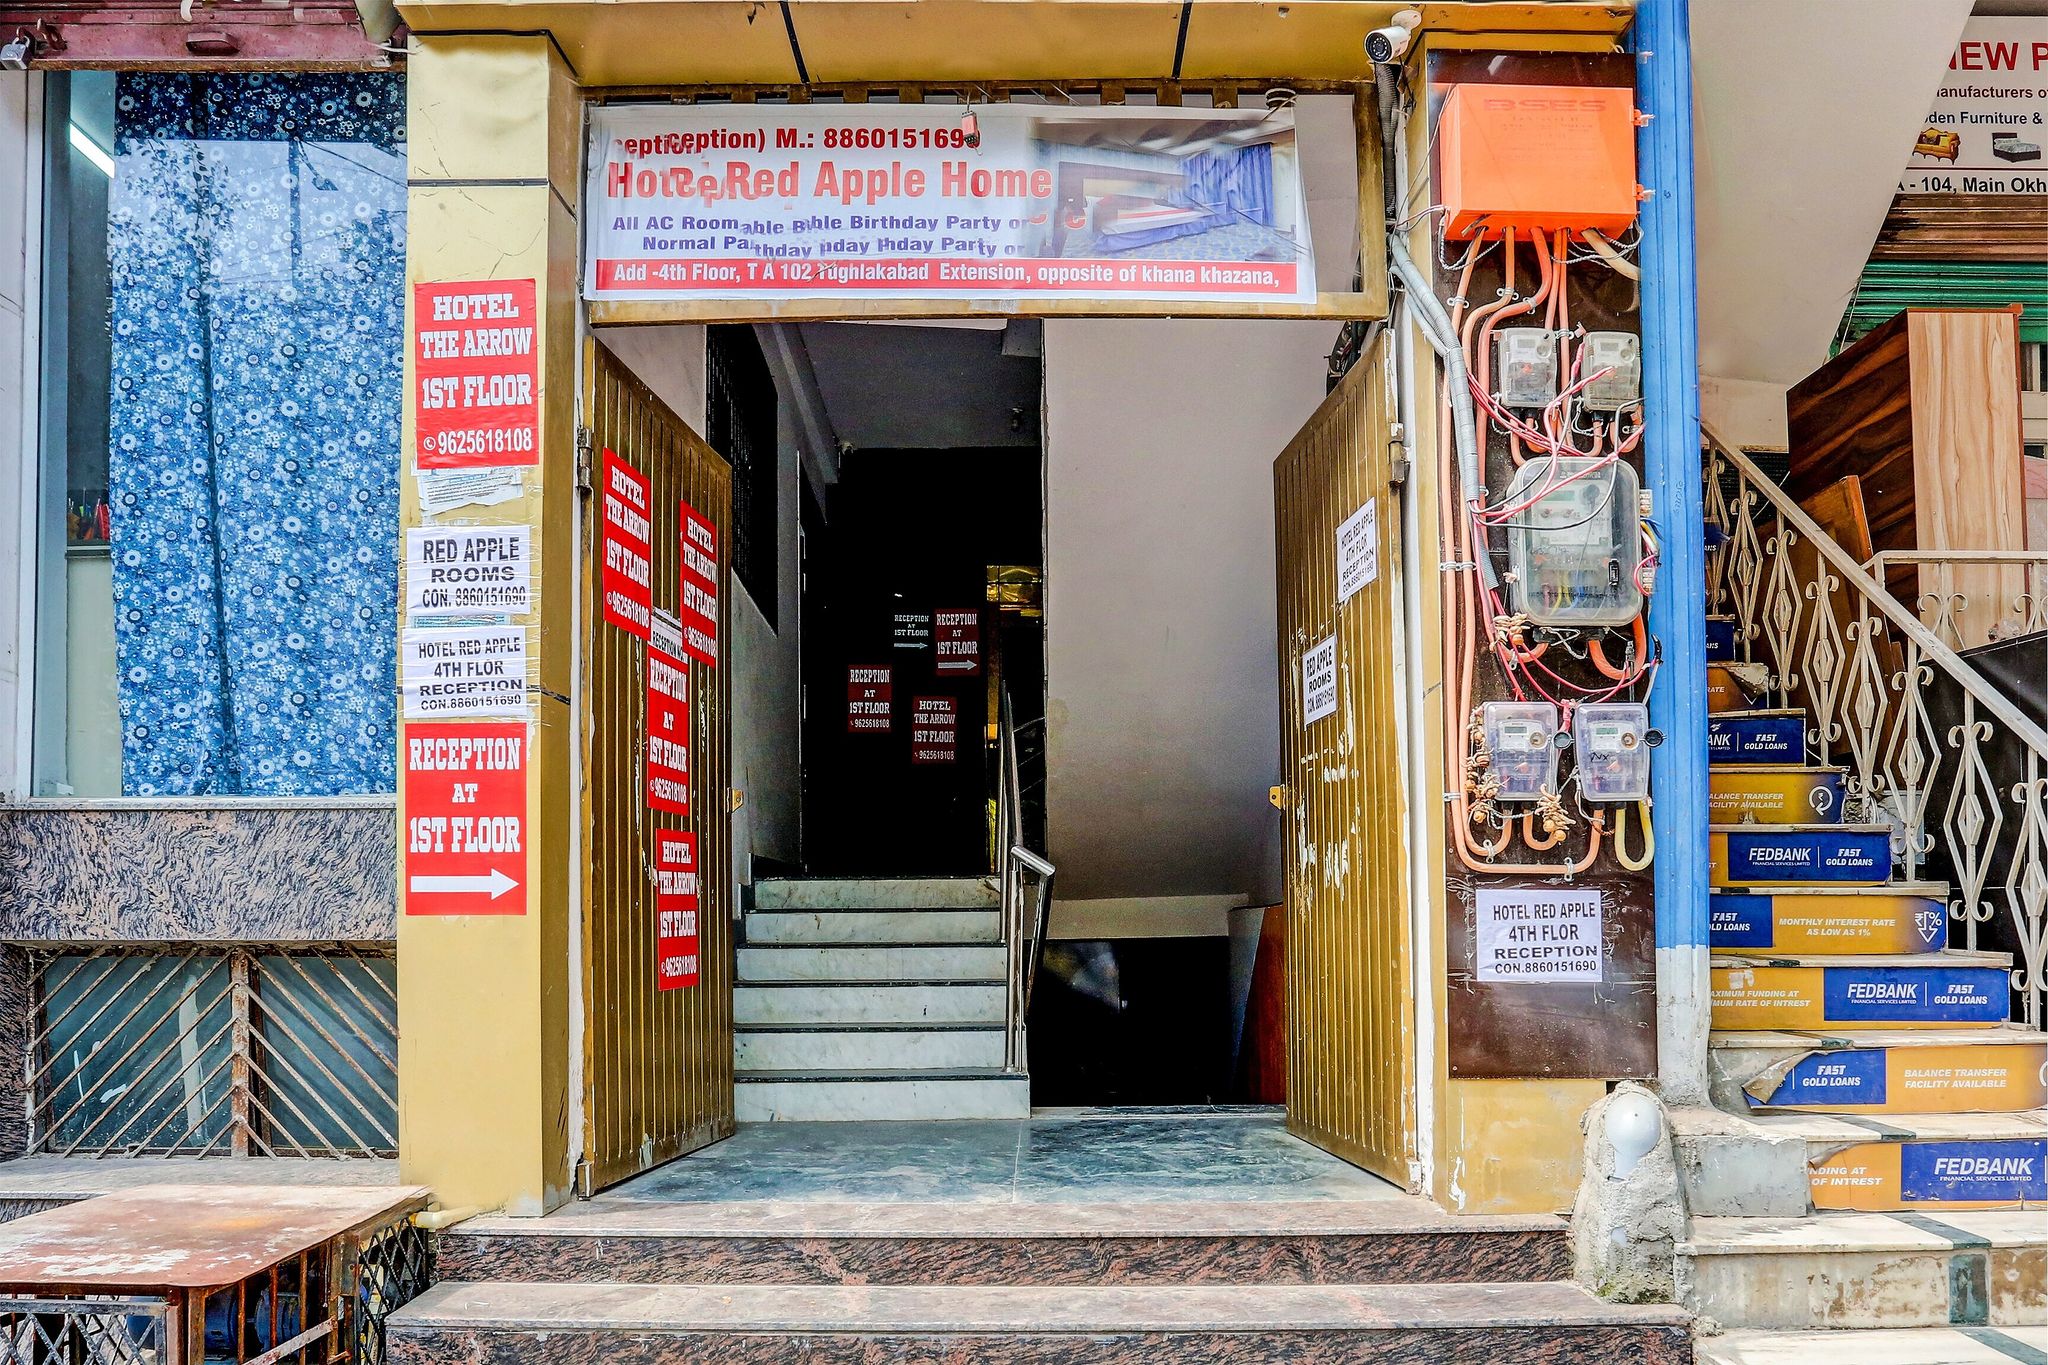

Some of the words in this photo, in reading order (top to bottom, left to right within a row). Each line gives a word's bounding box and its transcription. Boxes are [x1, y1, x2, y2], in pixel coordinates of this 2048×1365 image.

[1925, 112, 1955, 124] den
[1960, 112, 2027, 124] Furniture
[2032, 112, 2043, 124] &
[776, 128, 814, 149] M.:
[813, 161, 926, 206] Apple
[942, 161, 1052, 198] Home
[1921, 177, 1957, 194] 104,
[1963, 178, 2005, 193] Main
[612, 216, 639, 231] All
[646, 216, 674, 231] AC
[850, 215, 938, 232] Birthday
[946, 215, 1002, 232] Party
[643, 237, 716, 251] Normal
[614, 264, 647, 281] Add
[652, 264, 687, 281] -4th
[692, 264, 741, 283] Floor,
[747, 264, 757, 281] T
[763, 264, 775, 281] A
[781, 264, 811, 281] 102
[817, 263, 929, 284] Tughlakabad
[940, 264, 1032, 283] Extension,
[1037, 265, 1114, 284] opposite
[1119, 265, 1137, 282] of
[1142, 266, 1195, 283] khana
[1200, 266, 1280, 287] khazana,
[432, 293, 519, 321] HOTEL
[420, 330, 459, 359] THE
[463, 327, 532, 357] ARROW
[422, 377, 458, 409] 1ST
[463, 373, 532, 407] FLOOR
[438, 427, 532, 455] 9625618108
[611, 464, 645, 510] HOTEL
[605, 493, 623, 528] THE
[687, 516, 714, 554] HOTEL
[423, 538, 458, 563] RED
[463, 536, 520, 562] APPLE
[606, 537, 622, 573] 1ST
[622, 546, 650, 589] FLOOR
[431, 566, 515, 583] ROOMS
[894, 614, 929, 622] RECEPTION
[936, 613, 977, 626] RECEPTION
[907, 629, 929, 637] FLOOR
[952, 629, 962, 637] AT
[418, 641, 456, 659] HOTEL
[459, 639, 481, 655] RED
[485, 637, 521, 654] APPLE
[937, 641, 951, 655] 1ST
[952, 641, 978, 655] FLOOR
[434, 661, 462, 678] 4TH
[467, 660, 504, 677] FLOR
[850, 669, 890, 683] RECEPTION
[650, 657, 687, 703] RECEPTION
[1308, 670, 1332, 694] ROOMS
[419, 679, 523, 697] RECEPTION
[864, 689, 876, 698] AT
[849, 702, 864, 714] 1ST
[864, 702, 890, 714] FLOOR
[919, 700, 951, 711] HOTEL
[663, 711, 674, 731] AT
[914, 713, 928, 724] THE
[929, 713, 956, 724] ARROW
[914, 730, 928, 742] 1ST
[929, 730, 955, 743] FLOOR
[1755, 733, 1778, 742] FAST
[649, 735, 663, 765] 1ST
[663, 739, 687, 772] FLOOR
[1744, 742, 1763, 750] GOLD
[1765, 742, 1788, 750] LOANS
[409, 737, 521, 771] RECEPTION
[451, 783, 478, 803] AT
[410, 817, 447, 853] 1ST
[451, 817, 521, 853] FLOOR
[662, 841, 691, 864] HOTEL
[1748, 847, 1811, 861] FEDBANK
[1837, 848, 1861, 857] FAST
[1826, 858, 1847, 866] GOLD
[1848, 858, 1873, 866] LOANS
[658, 870, 672, 895] THE
[1493, 904, 1531, 921] HOTEL
[1534, 903, 1556, 919] RED
[1560, 902, 1596, 918] APPLE
[1712, 912, 1738, 921] FAST
[660, 911, 673, 938] 1ST
[673, 910, 696, 937] FLOOR
[1724, 923, 1751, 931] LOANS
[1778, 917, 1823, 926] MONTHLY
[1825, 917, 1868, 926] INTEREST
[1871, 918, 1895, 927] RATE
[1509, 925, 1537, 942] 4TH
[1542, 924, 1579, 941] FLOR
[1806, 928, 1819, 936] AS
[1820, 928, 1840, 936] LOW
[1842, 928, 1856, 936] AS
[1858, 928, 1871, 937] 1%
[1494, 945, 1598, 960] RECEPTION
[1495, 961, 1597, 974] CON.8860151690
[1846, 983, 1917, 998] FEDBANK
[1947, 984, 1975, 994] FAST
[1934, 995, 1958, 1005] GOLD
[1960, 995, 1988, 1005] LOANS
[1817, 1065, 1846, 1076] FAST
[1904, 1069, 1951, 1078] BALANCE
[1954, 1068, 2007, 1077] TRANSFER
[1803, 1077, 1828, 1087] GOLD
[1830, 1077, 1861, 1086] LOANS
[1904, 1079, 1949, 1088] FACILITY
[1951, 1079, 2007, 1088] AVAILABLE
[1850, 1167, 1867, 1175] AT
[1934, 1157, 2035, 1175] FEDBANK
[1831, 1177, 1883, 1186] INTREST
